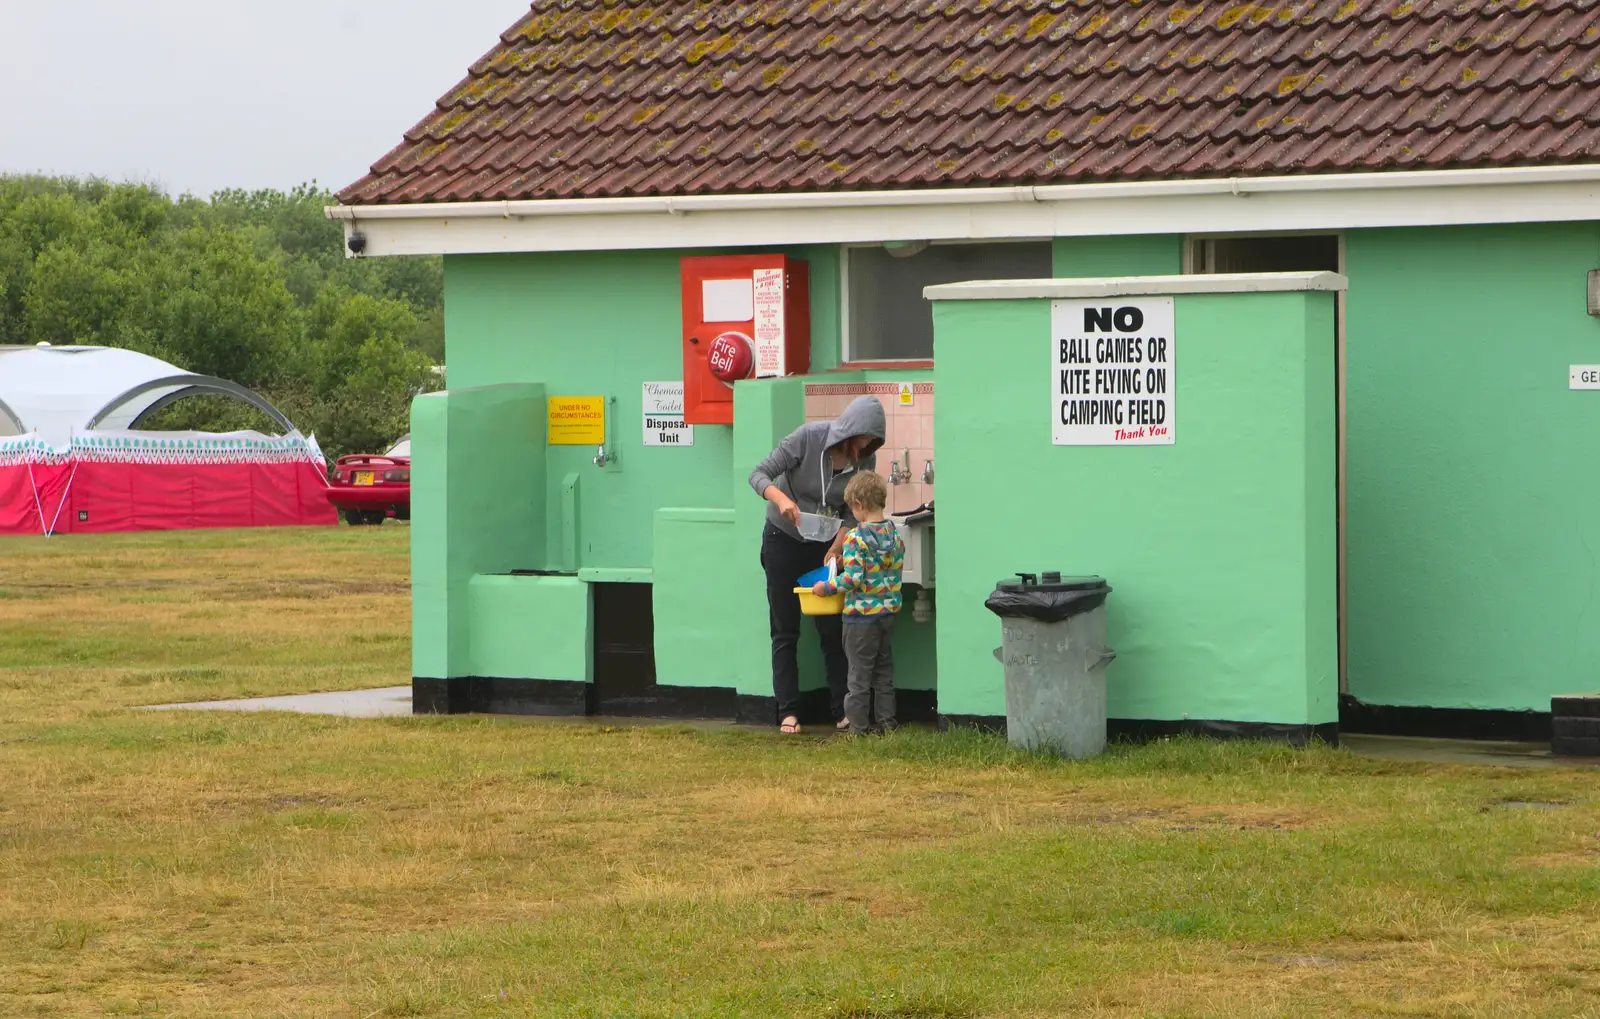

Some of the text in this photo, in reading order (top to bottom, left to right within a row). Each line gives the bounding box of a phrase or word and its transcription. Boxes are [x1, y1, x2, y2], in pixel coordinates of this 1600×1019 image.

[1084, 306, 1144, 333] NO
[715, 337, 736, 358] Fire
[1060, 337, 1167, 364] BALL GAMES OR
[711, 351, 733, 372] Bell
[647, 383, 684, 396] Chemica
[1060, 368, 1166, 394] KITE FLYING ON
[653, 399, 683, 411] Toilet
[1061, 399, 1166, 425] CAMPING FIELD
[659, 432, 680, 443] Unit
[1115, 424, 1167, 440] Thank You
[1006, 654, 1040, 667] WASTE
